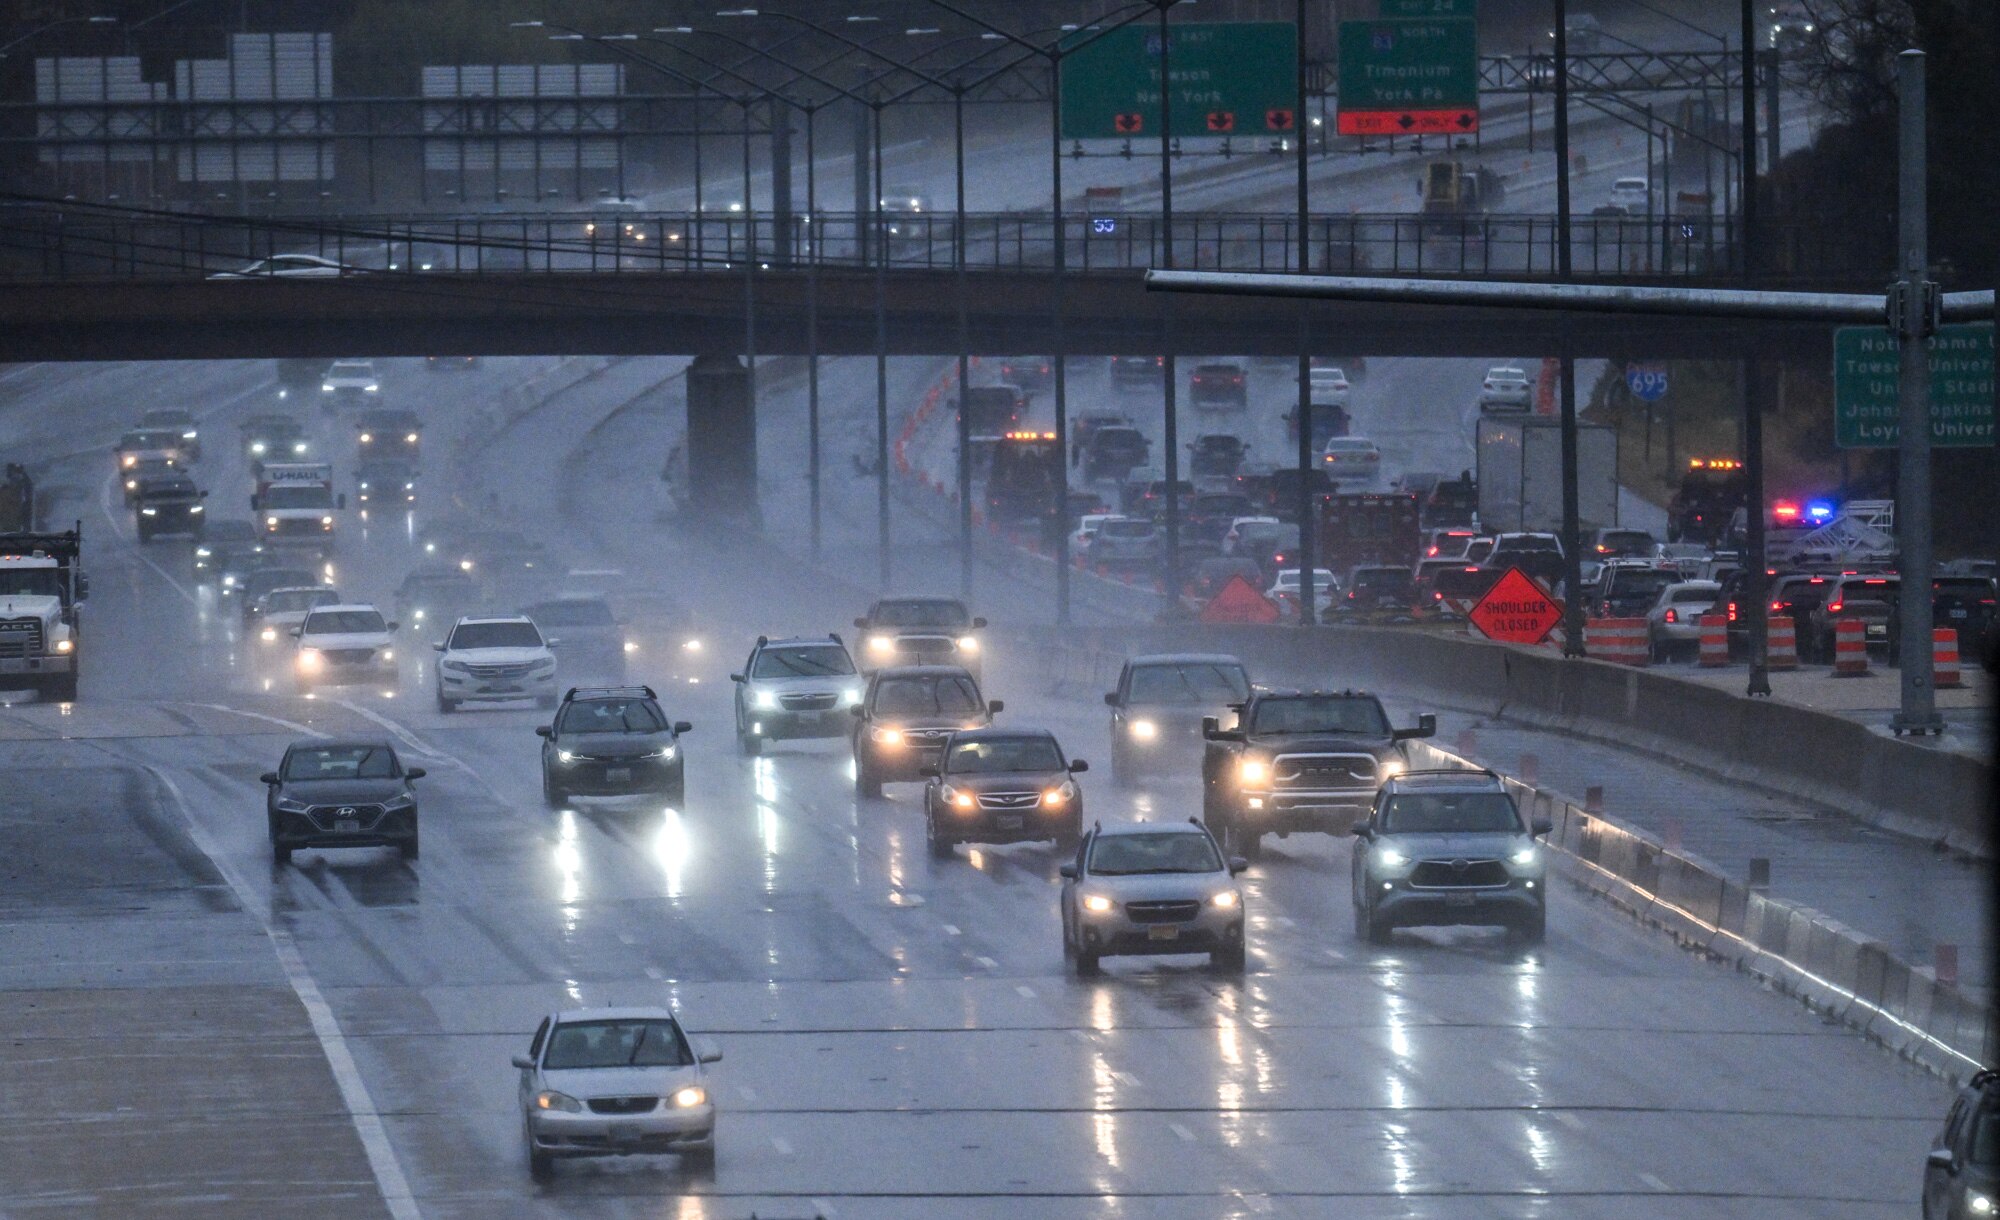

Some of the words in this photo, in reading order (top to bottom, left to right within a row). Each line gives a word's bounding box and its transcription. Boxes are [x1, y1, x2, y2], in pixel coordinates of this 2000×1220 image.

[1433, 0, 1453, 10] 24
[1364, 64, 1451, 77] Timonium
[1183, 88, 1221, 102] York
[1374, 88, 1413, 100] York
[1632, 372, 1668, 393] 695
[1929, 403, 1993, 419] opkins
[272, 471, 321, 481] U-HAUL
[1484, 601, 1547, 614] SHOULDER
[1493, 618, 1538, 632] CLOSED
